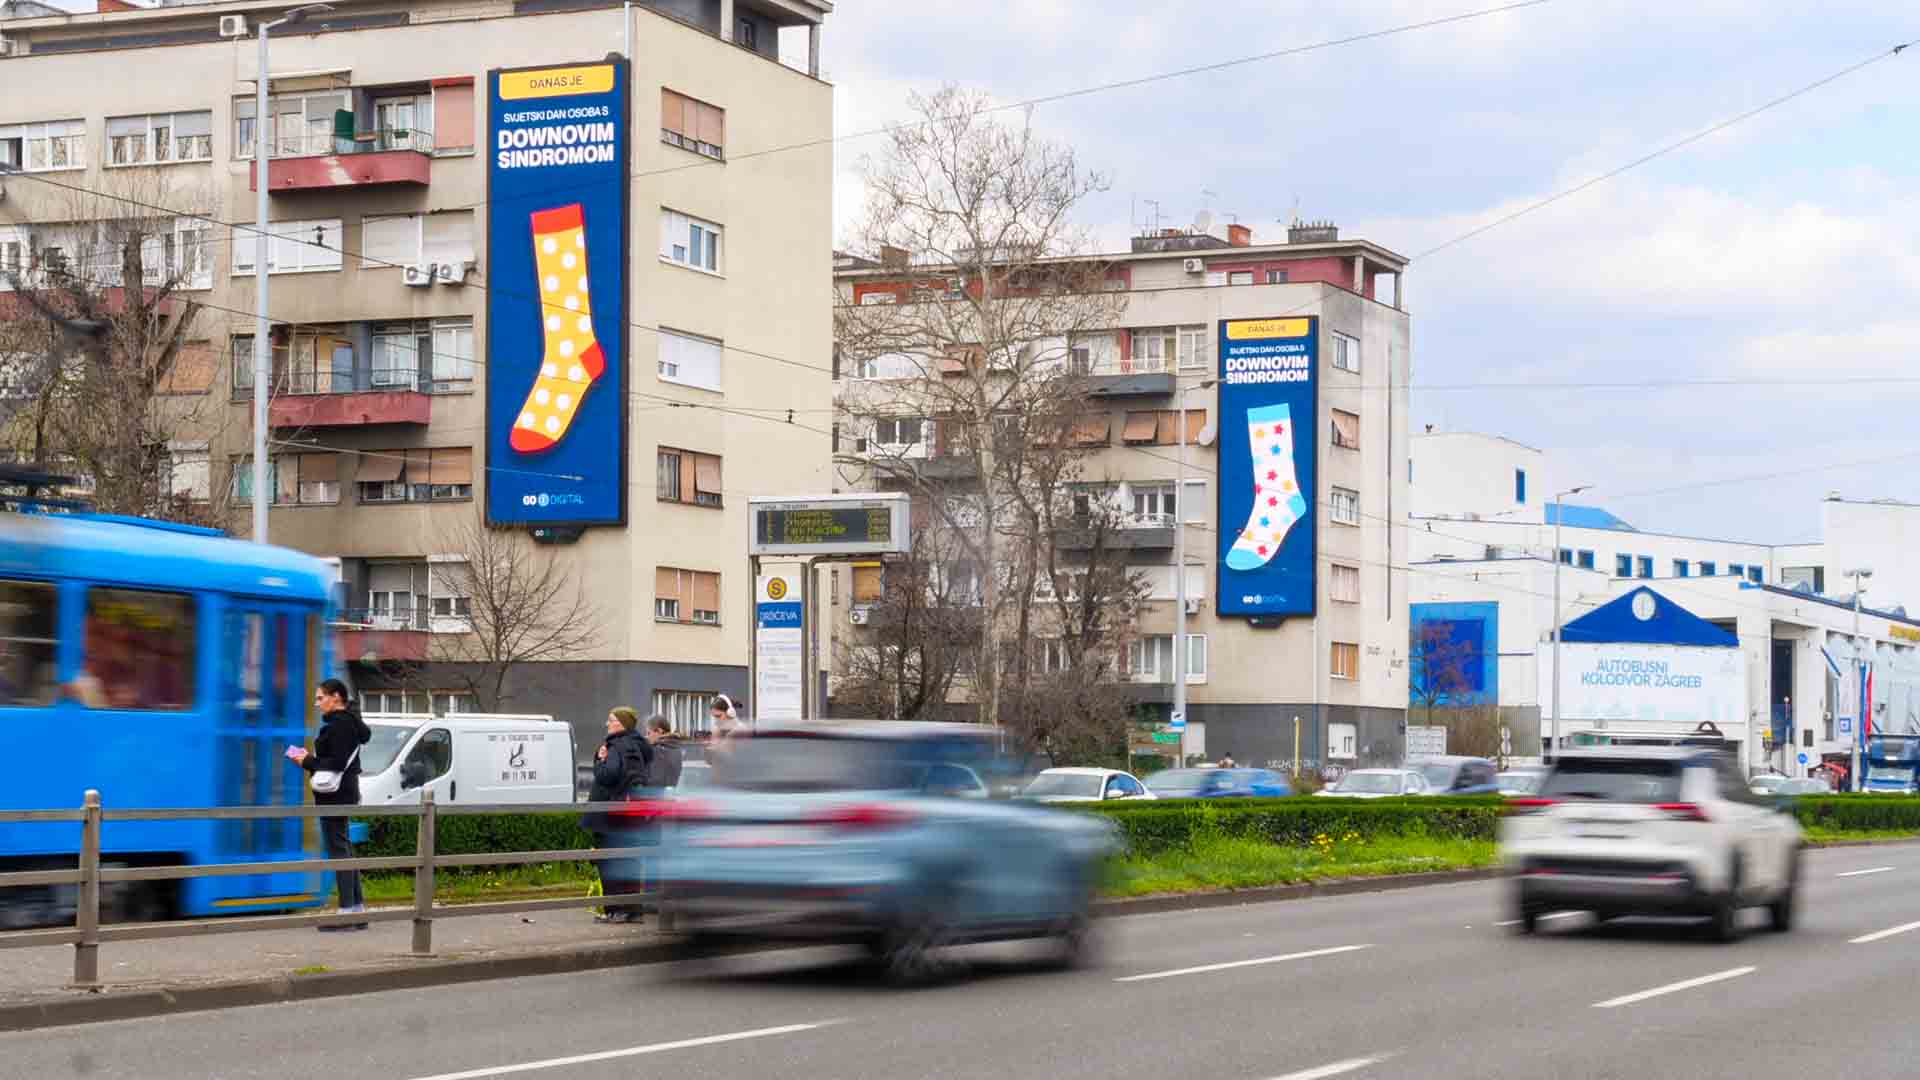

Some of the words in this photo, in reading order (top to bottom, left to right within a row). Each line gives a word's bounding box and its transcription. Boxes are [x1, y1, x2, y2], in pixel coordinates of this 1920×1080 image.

[530, 77, 567, 88] DANAS
[570, 76, 582, 85] JE
[504, 112, 545, 122] SVJETSKI
[546, 109, 566, 119] DAN
[568, 108, 600, 118] OSOBA
[498, 123, 613, 148] DOWNOVIM
[498, 145, 613, 167] SINDROMOM
[1226, 356, 1308, 370] DOWNOVIM
[1226, 370, 1308, 384] SINDROMOM
[1597, 659, 1668, 673] AUTOBUSNI
[1582, 672, 1650, 686] KOLODVOR
[1655, 674, 1702, 688] ZAGREB
